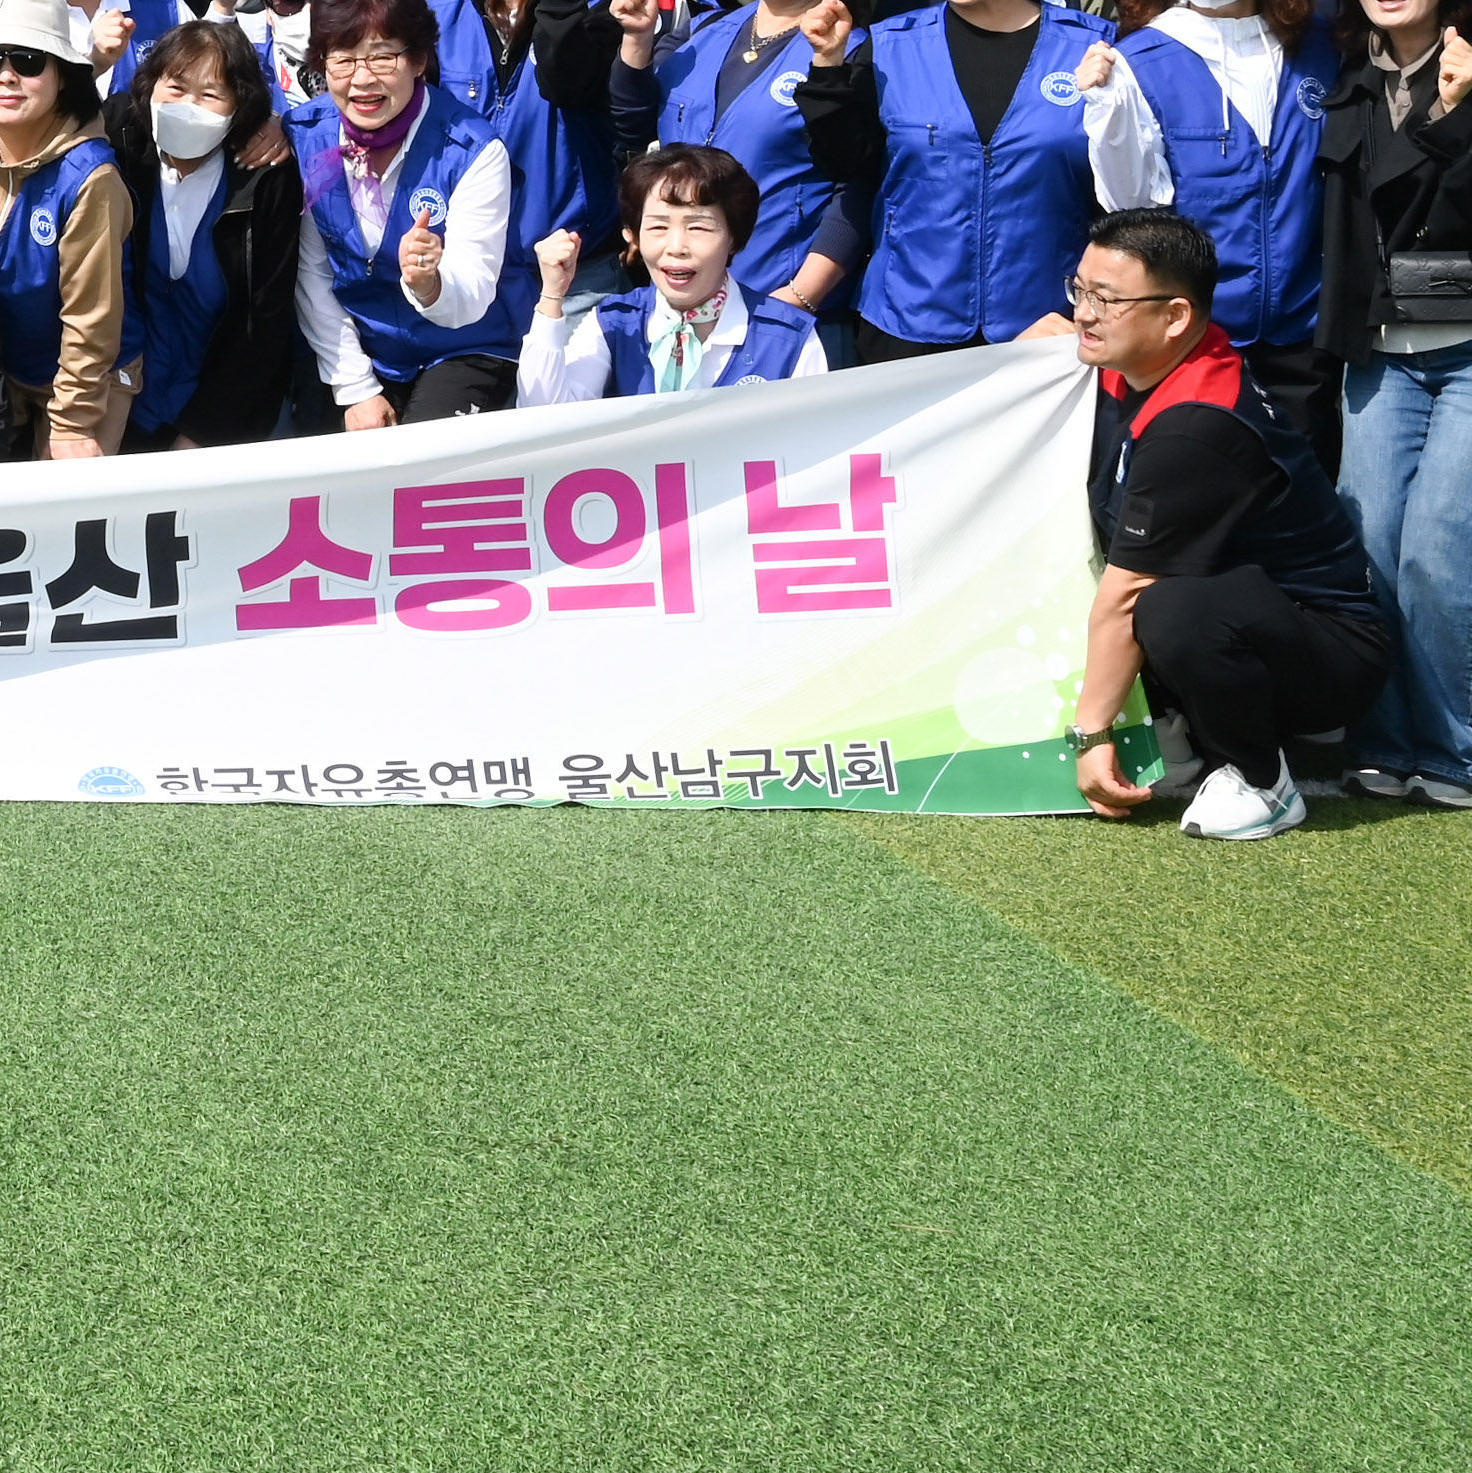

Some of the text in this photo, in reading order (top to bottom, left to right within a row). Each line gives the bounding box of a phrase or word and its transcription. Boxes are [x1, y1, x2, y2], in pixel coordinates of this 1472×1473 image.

[1050, 82, 1076, 94] KFF
[236, 463, 696, 632] 소통의
[744, 453, 897, 614] 날
[156, 740, 896, 800] 한국자유총연맹 울산남구지회
